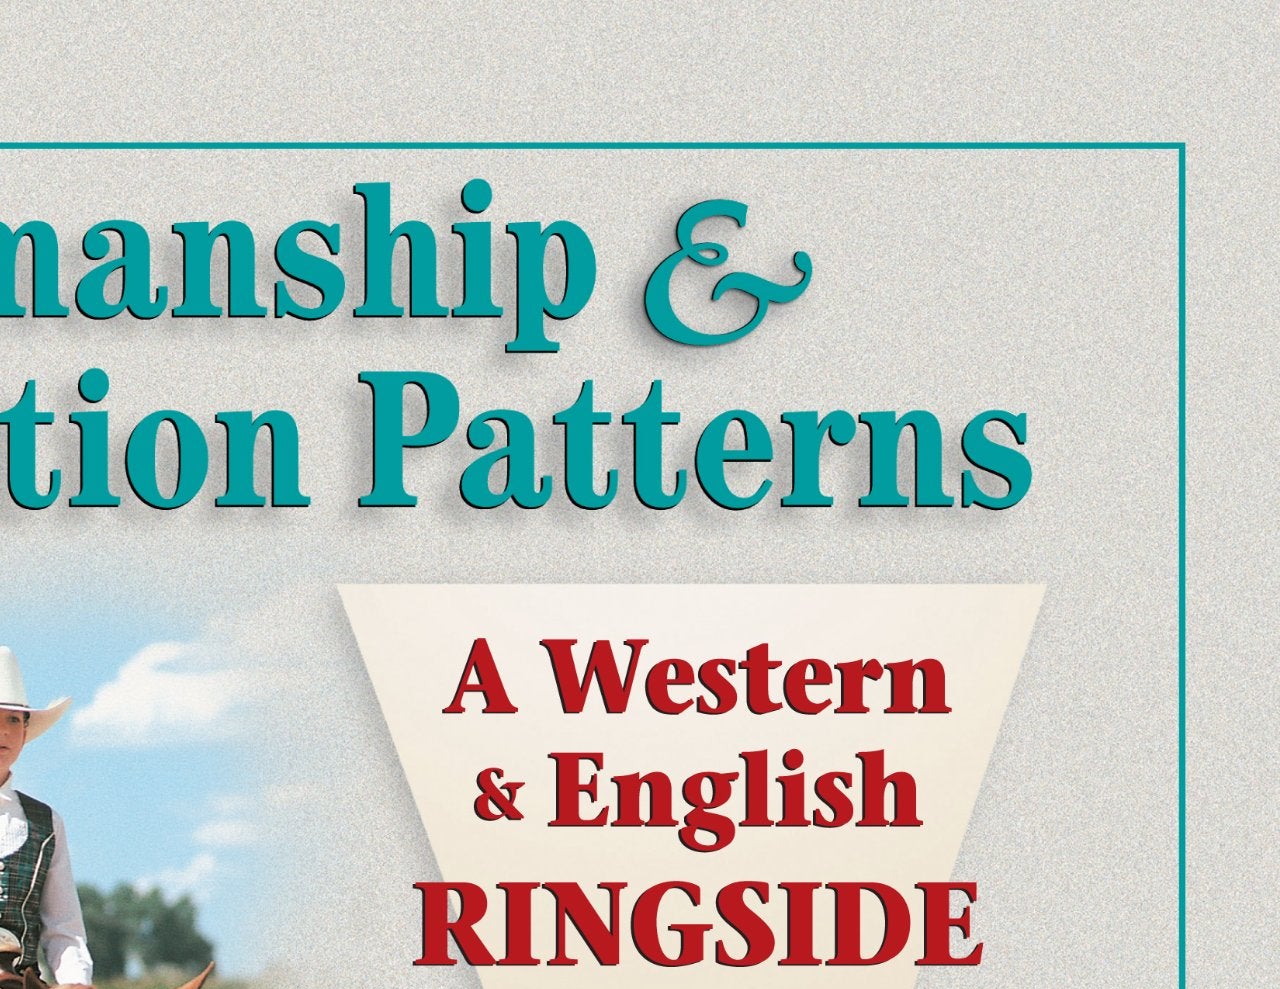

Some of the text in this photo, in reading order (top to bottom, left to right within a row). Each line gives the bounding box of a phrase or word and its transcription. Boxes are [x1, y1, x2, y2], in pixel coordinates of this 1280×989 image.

[644, 198, 814, 347] &
[357, 370, 1034, 511] Patterns
[443, 638, 952, 716] A Western
[475, 749, 923, 853] & English
[414, 880, 985, 968] RINGSIDE
